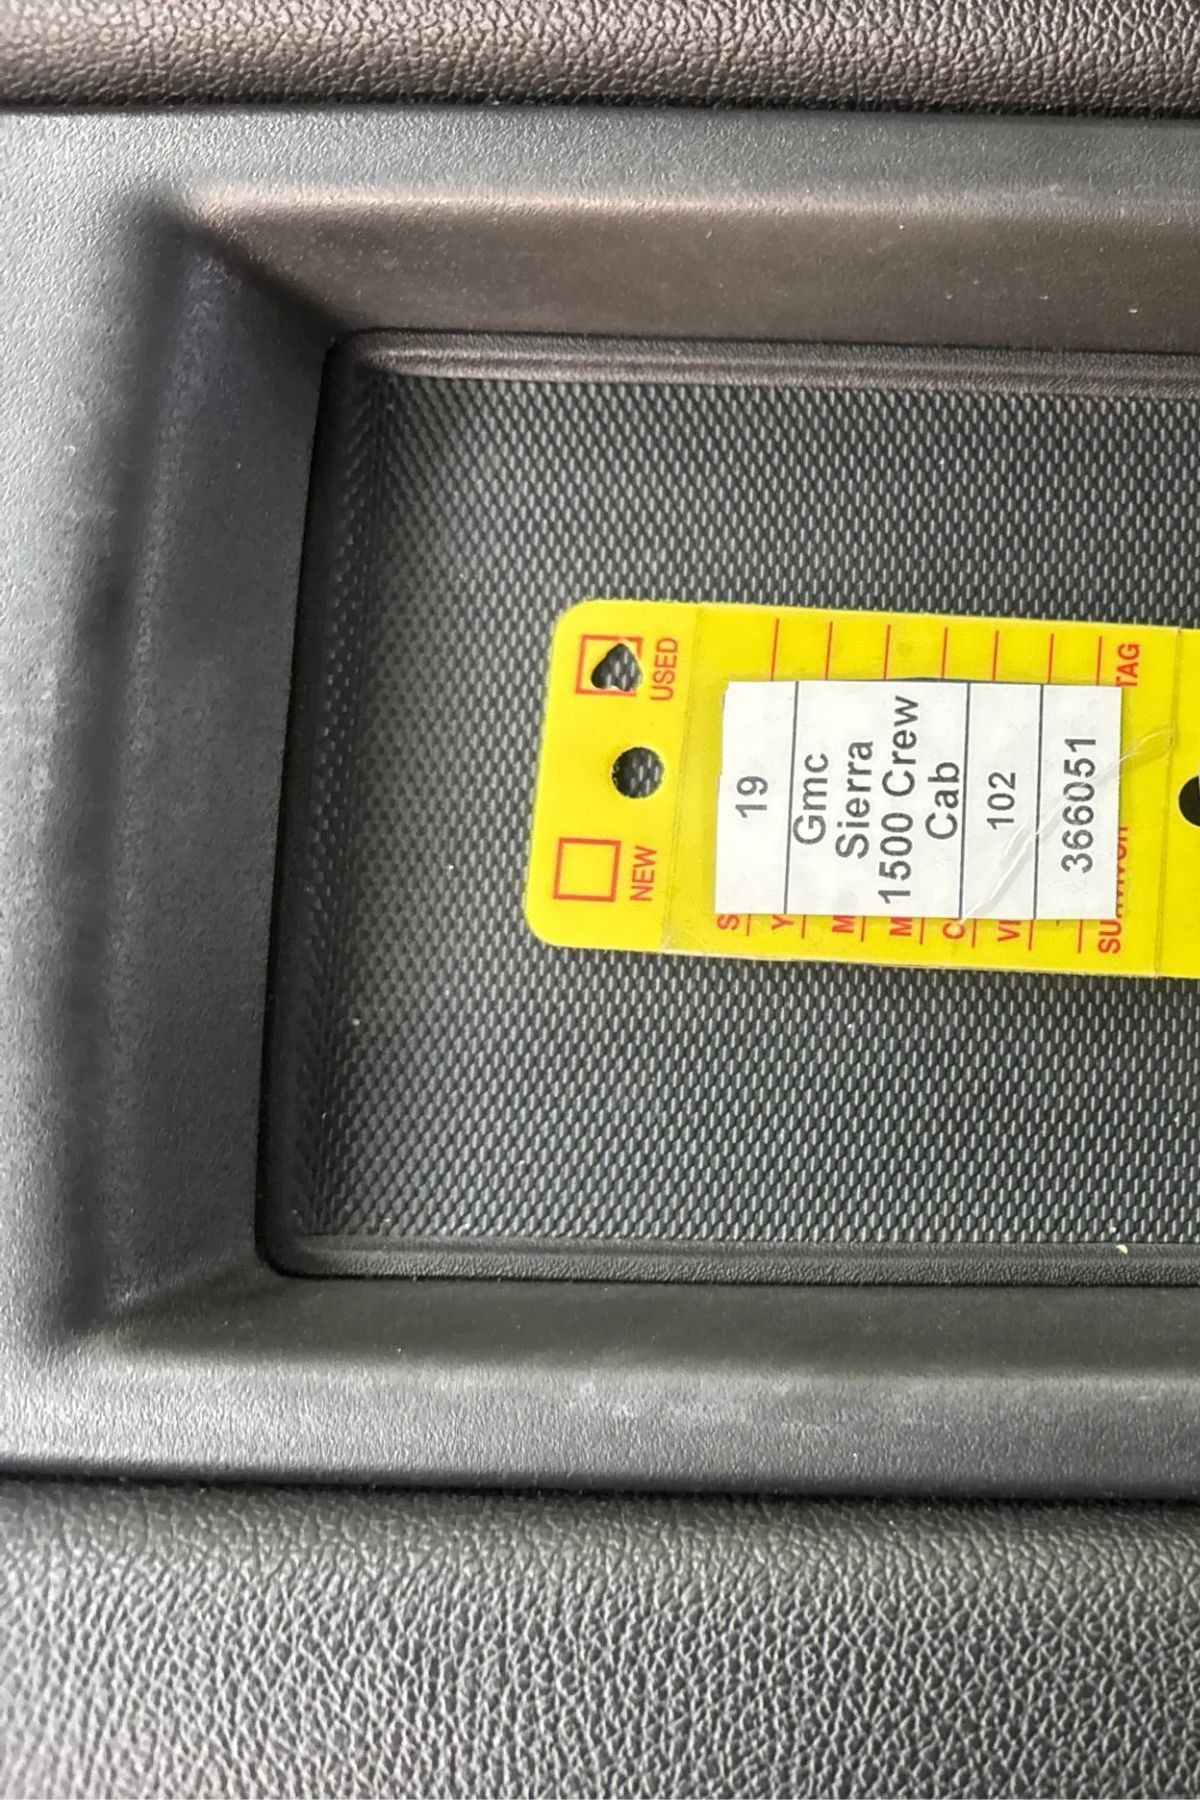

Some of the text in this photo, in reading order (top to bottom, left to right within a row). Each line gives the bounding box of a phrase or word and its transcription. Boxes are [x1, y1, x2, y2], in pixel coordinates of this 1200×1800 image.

[650, 636, 679, 702] USED
[1114, 642, 1141, 688] TAG
[881, 695, 919, 798] Crew
[735, 776, 768, 818] 19
[792, 752, 829, 845] Gmc
[835, 741, 873, 859] Sierra
[925, 762, 960, 840] Cab
[986, 772, 1016, 830] 102
[1061, 738, 1096, 873] 366051
[628, 844, 658, 902] NEW
[878, 812, 914, 904] 1500
